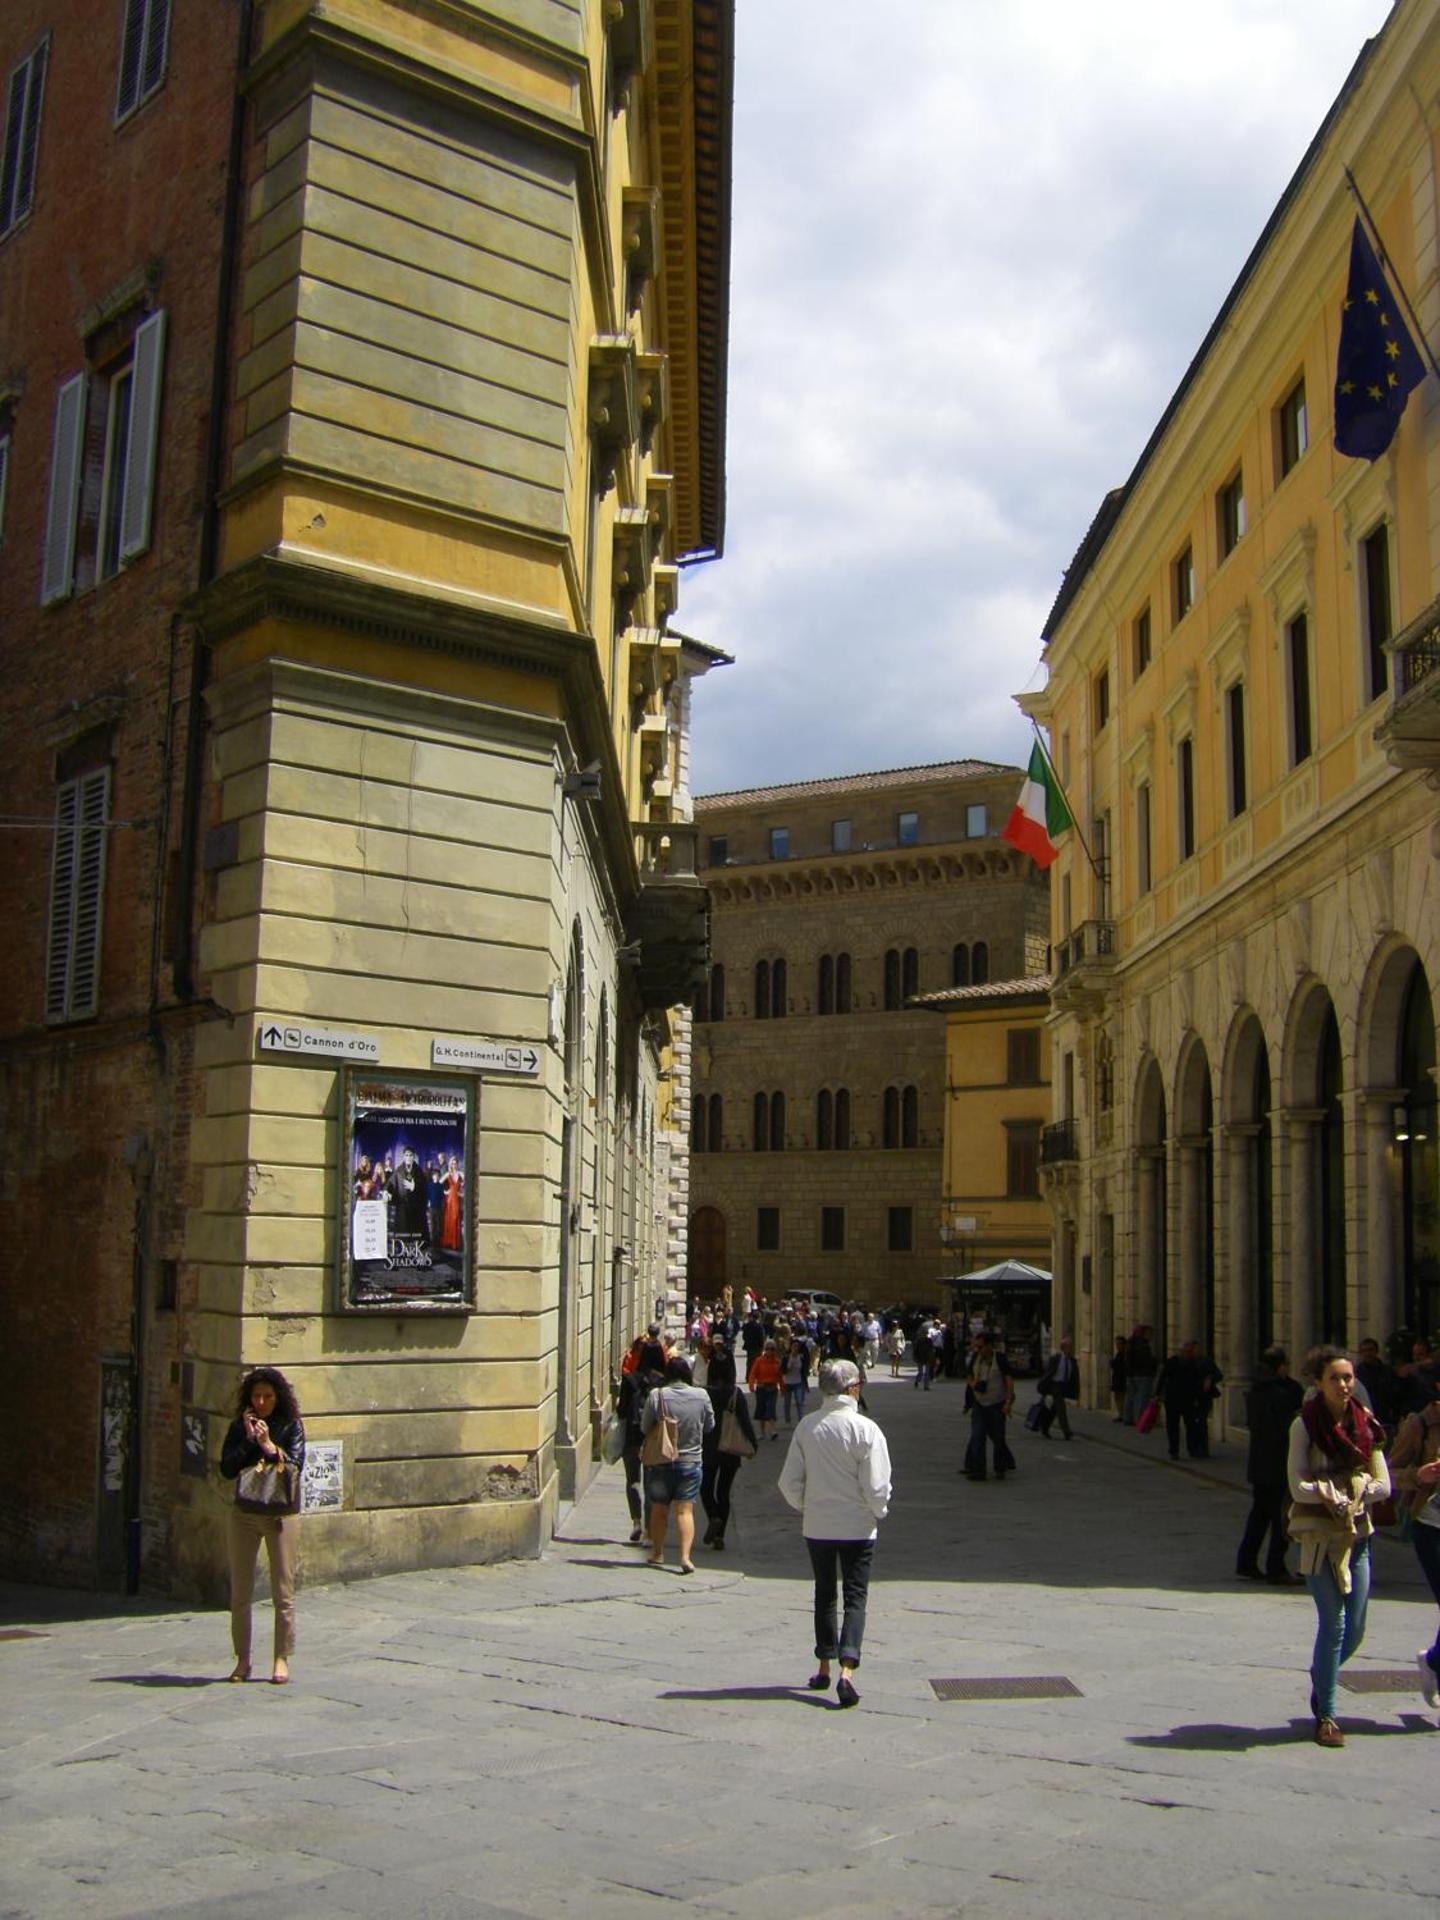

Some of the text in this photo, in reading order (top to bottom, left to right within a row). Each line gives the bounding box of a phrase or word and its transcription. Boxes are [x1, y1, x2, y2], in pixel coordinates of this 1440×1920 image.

[304, 1035, 377, 1053] Cannon d'Oro
[390, 1238, 425, 1258] DARK
[383, 1250, 433, 1270] SHADOWS
